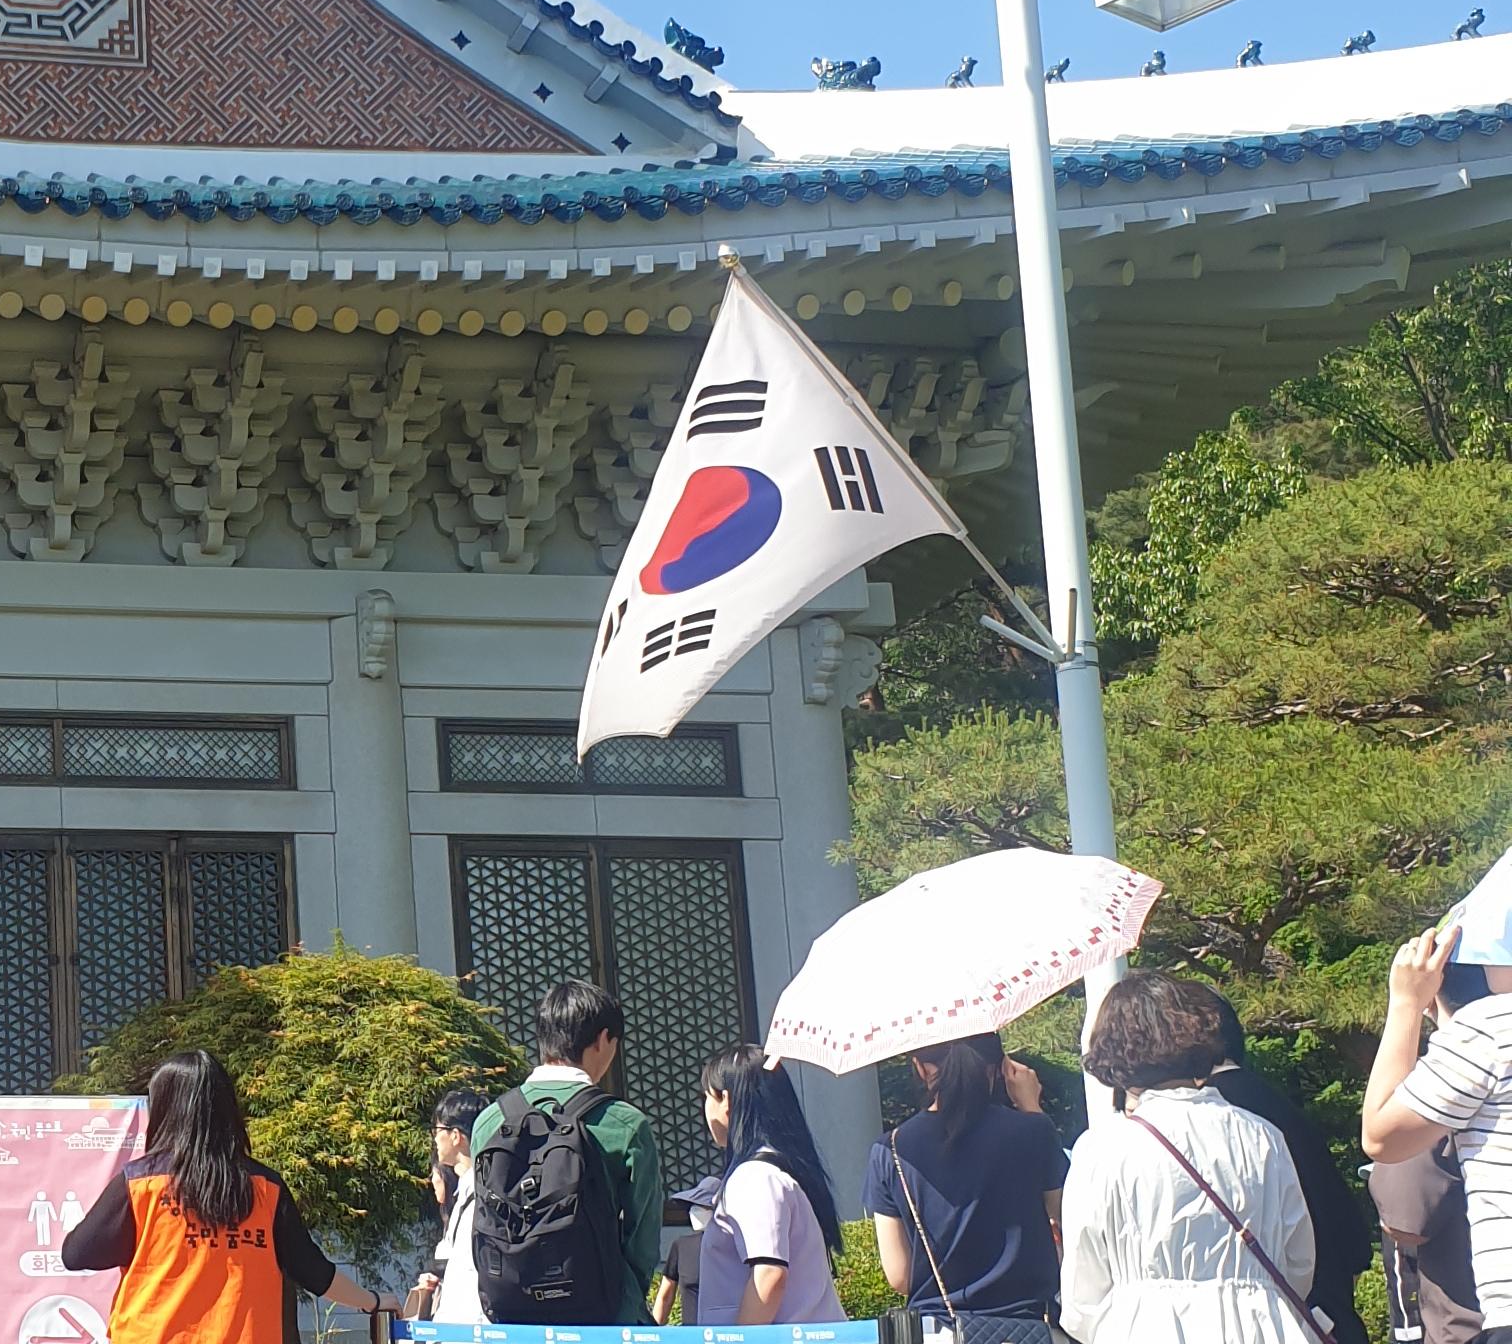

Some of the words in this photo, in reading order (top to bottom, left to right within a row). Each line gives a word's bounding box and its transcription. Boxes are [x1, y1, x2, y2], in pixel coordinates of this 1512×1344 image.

[10, 1122, 31, 1141] 국민
[35, 1120, 63, 1139] 품으로
[185, 1222, 218, 1249] 국민
[226, 1223, 267, 1249] 품으로
[32, 1254, 66, 1273] 화장
